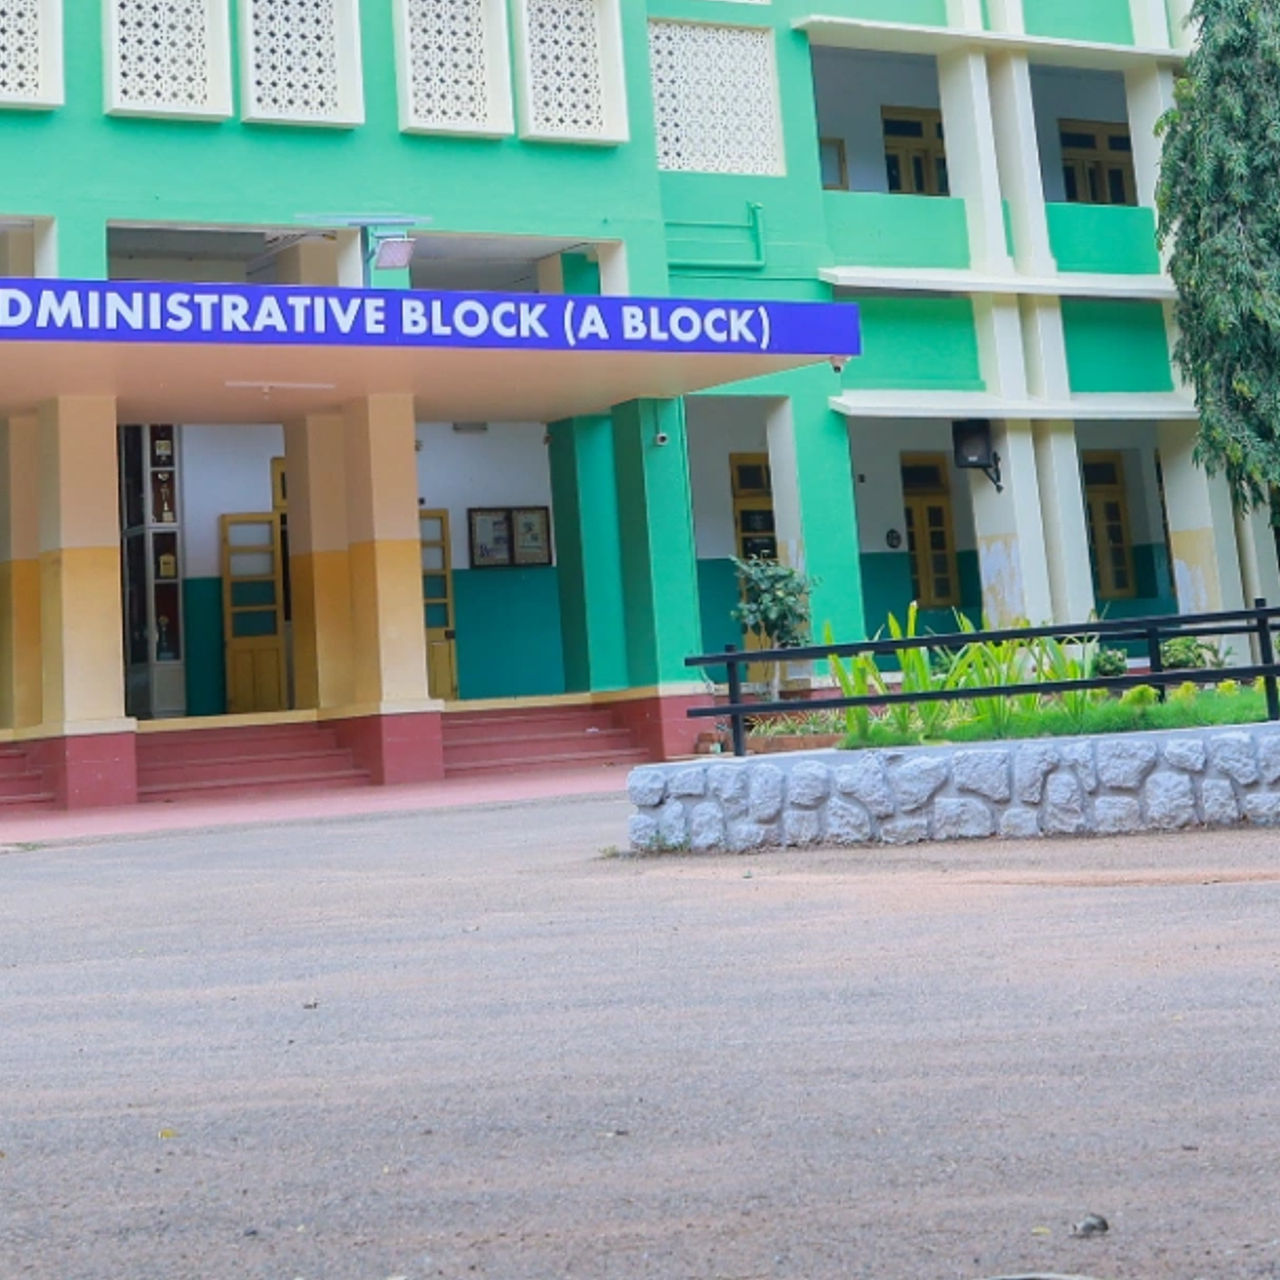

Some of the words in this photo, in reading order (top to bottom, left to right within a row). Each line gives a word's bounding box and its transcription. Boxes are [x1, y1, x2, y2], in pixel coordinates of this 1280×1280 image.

[402, 298, 549, 338] BLOCK
[564, 300, 610, 347] (A
[622, 305, 770, 350] BLOCK)
